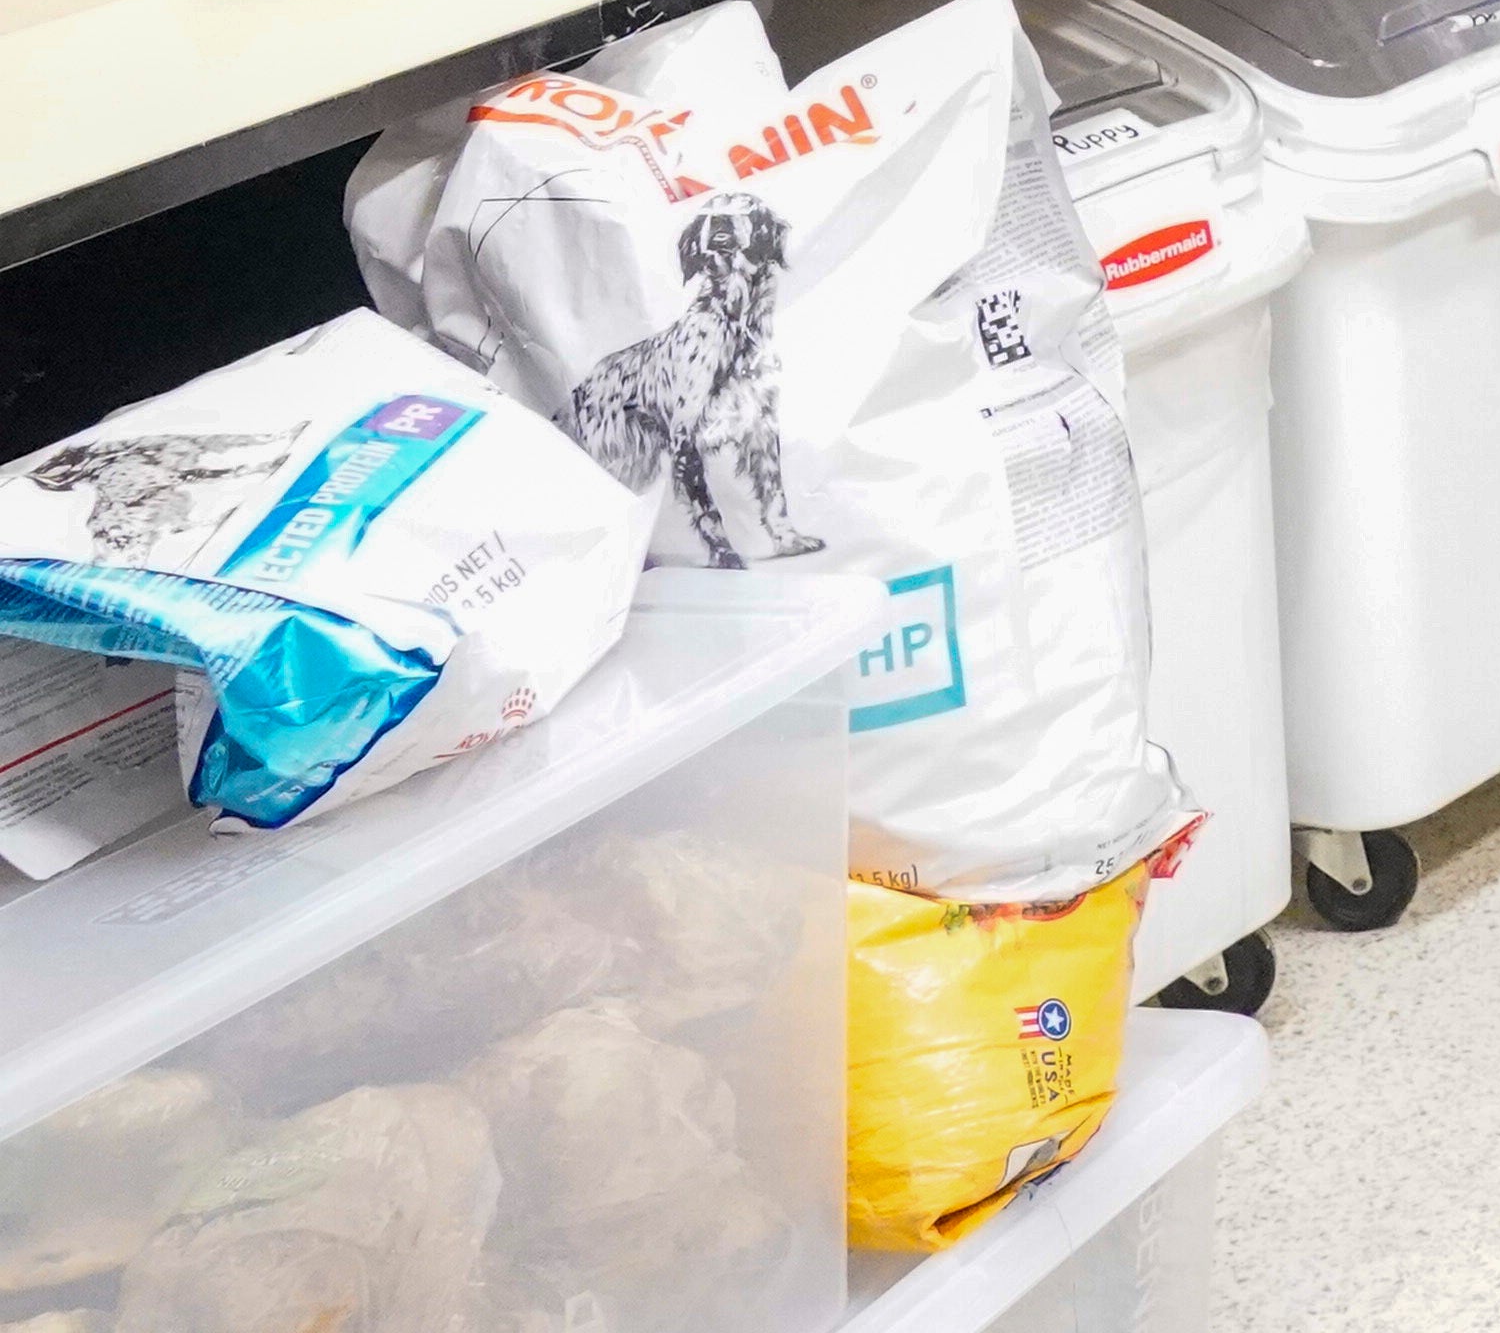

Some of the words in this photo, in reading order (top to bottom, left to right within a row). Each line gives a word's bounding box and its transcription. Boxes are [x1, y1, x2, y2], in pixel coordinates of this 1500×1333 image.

[1052, 121, 1139, 155] Puppy
[1104, 228, 1208, 281] Rubbermaid
[382, 401, 444, 435] PR
[254, 510, 335, 584] ECTED
[315, 439, 401, 506] PROTEIN
[454, 540, 494, 581] NET
[858, 622, 933, 678] HP
[1040, 1049, 1059, 1103] USA
